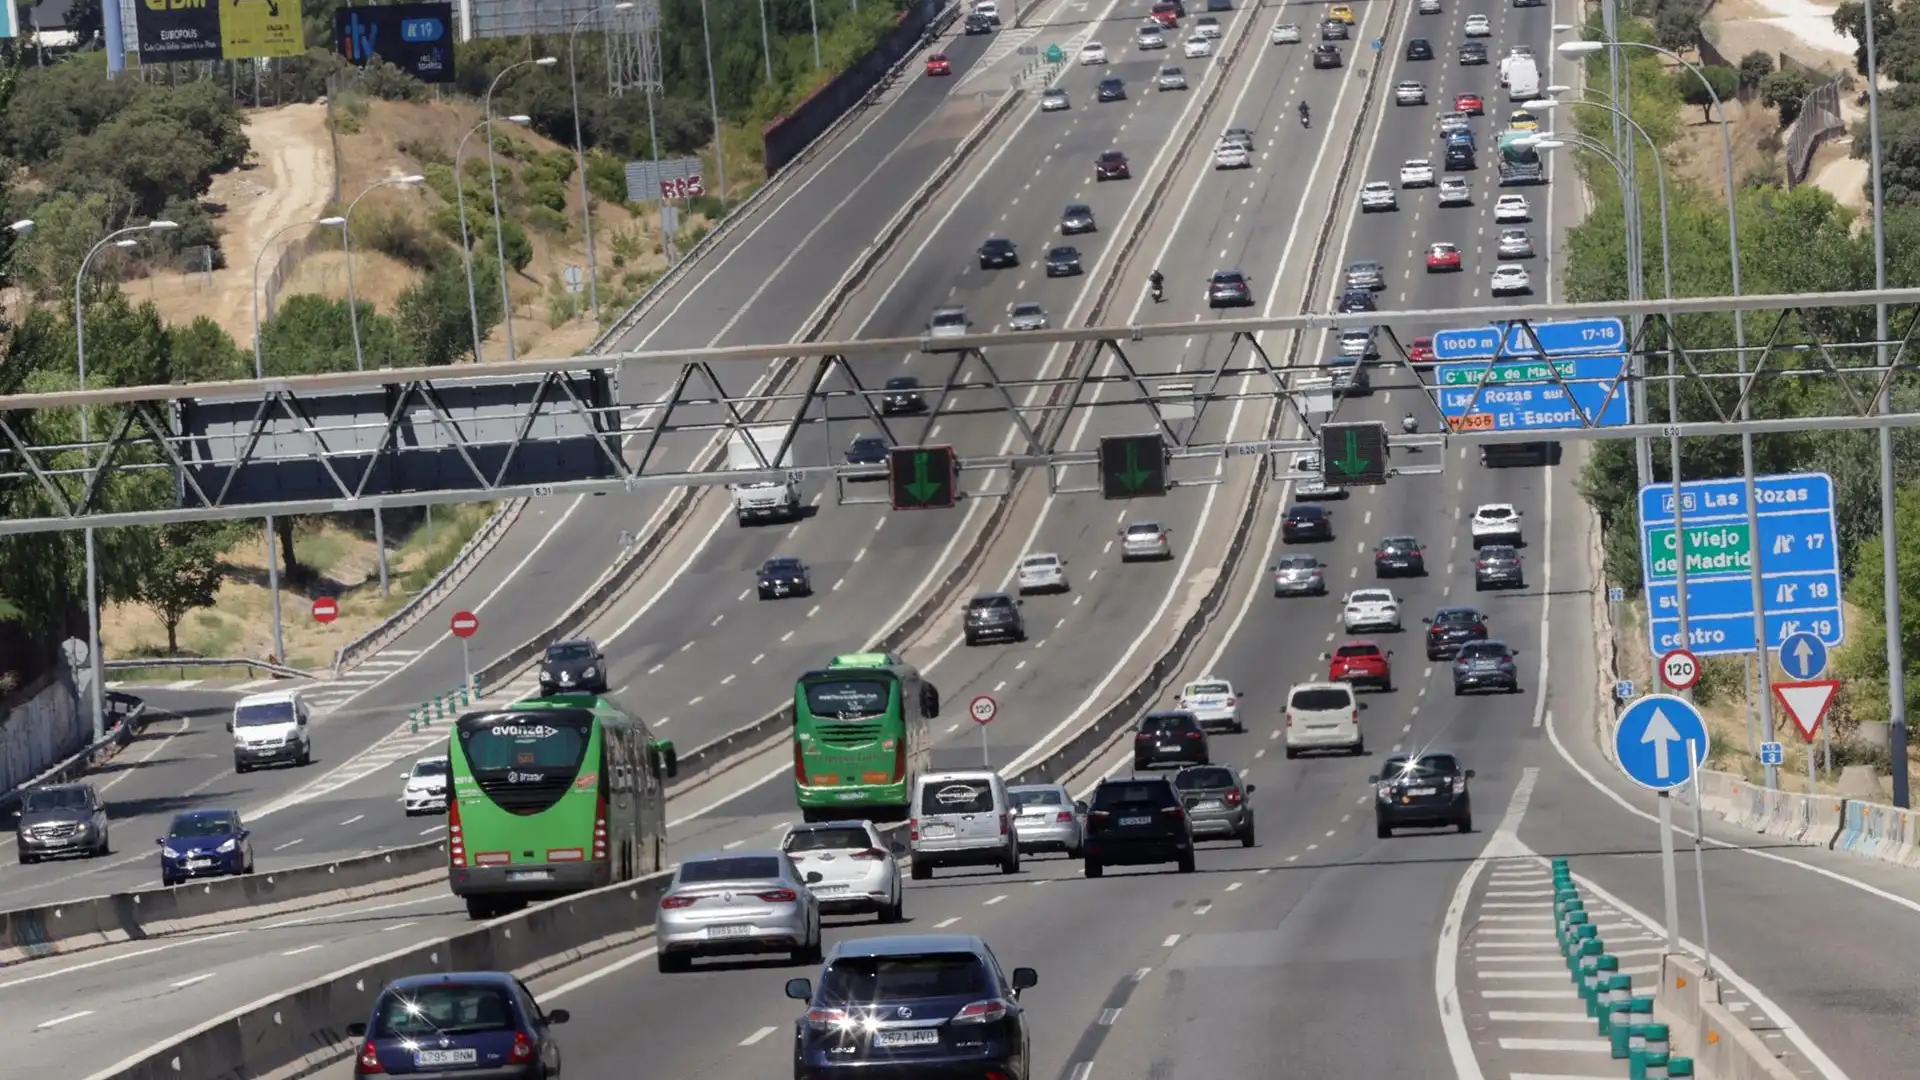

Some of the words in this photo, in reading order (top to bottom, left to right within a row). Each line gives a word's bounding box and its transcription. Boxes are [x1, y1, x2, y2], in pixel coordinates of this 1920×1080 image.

[1582, 327, 1615, 340] 17-18
[1443, 338, 1475, 350] 1000
[1481, 340, 1493, 348] m
[1504, 369, 1521, 380] de
[1485, 389, 1532, 403] Rozas
[1543, 389, 1564, 400] sur
[1499, 413, 1515, 427] El
[1704, 491, 1739, 508] Las
[1690, 529, 1740, 549] Viejo
[1805, 533, 1825, 549] 17
[1686, 550, 1752, 570] Madrid
[1808, 582, 1829, 598] 18
[1811, 620, 1831, 636] 19
[1667, 663, 1693, 677] 120
[975, 703, 991, 714] 120
[492, 725, 544, 736] avanza
